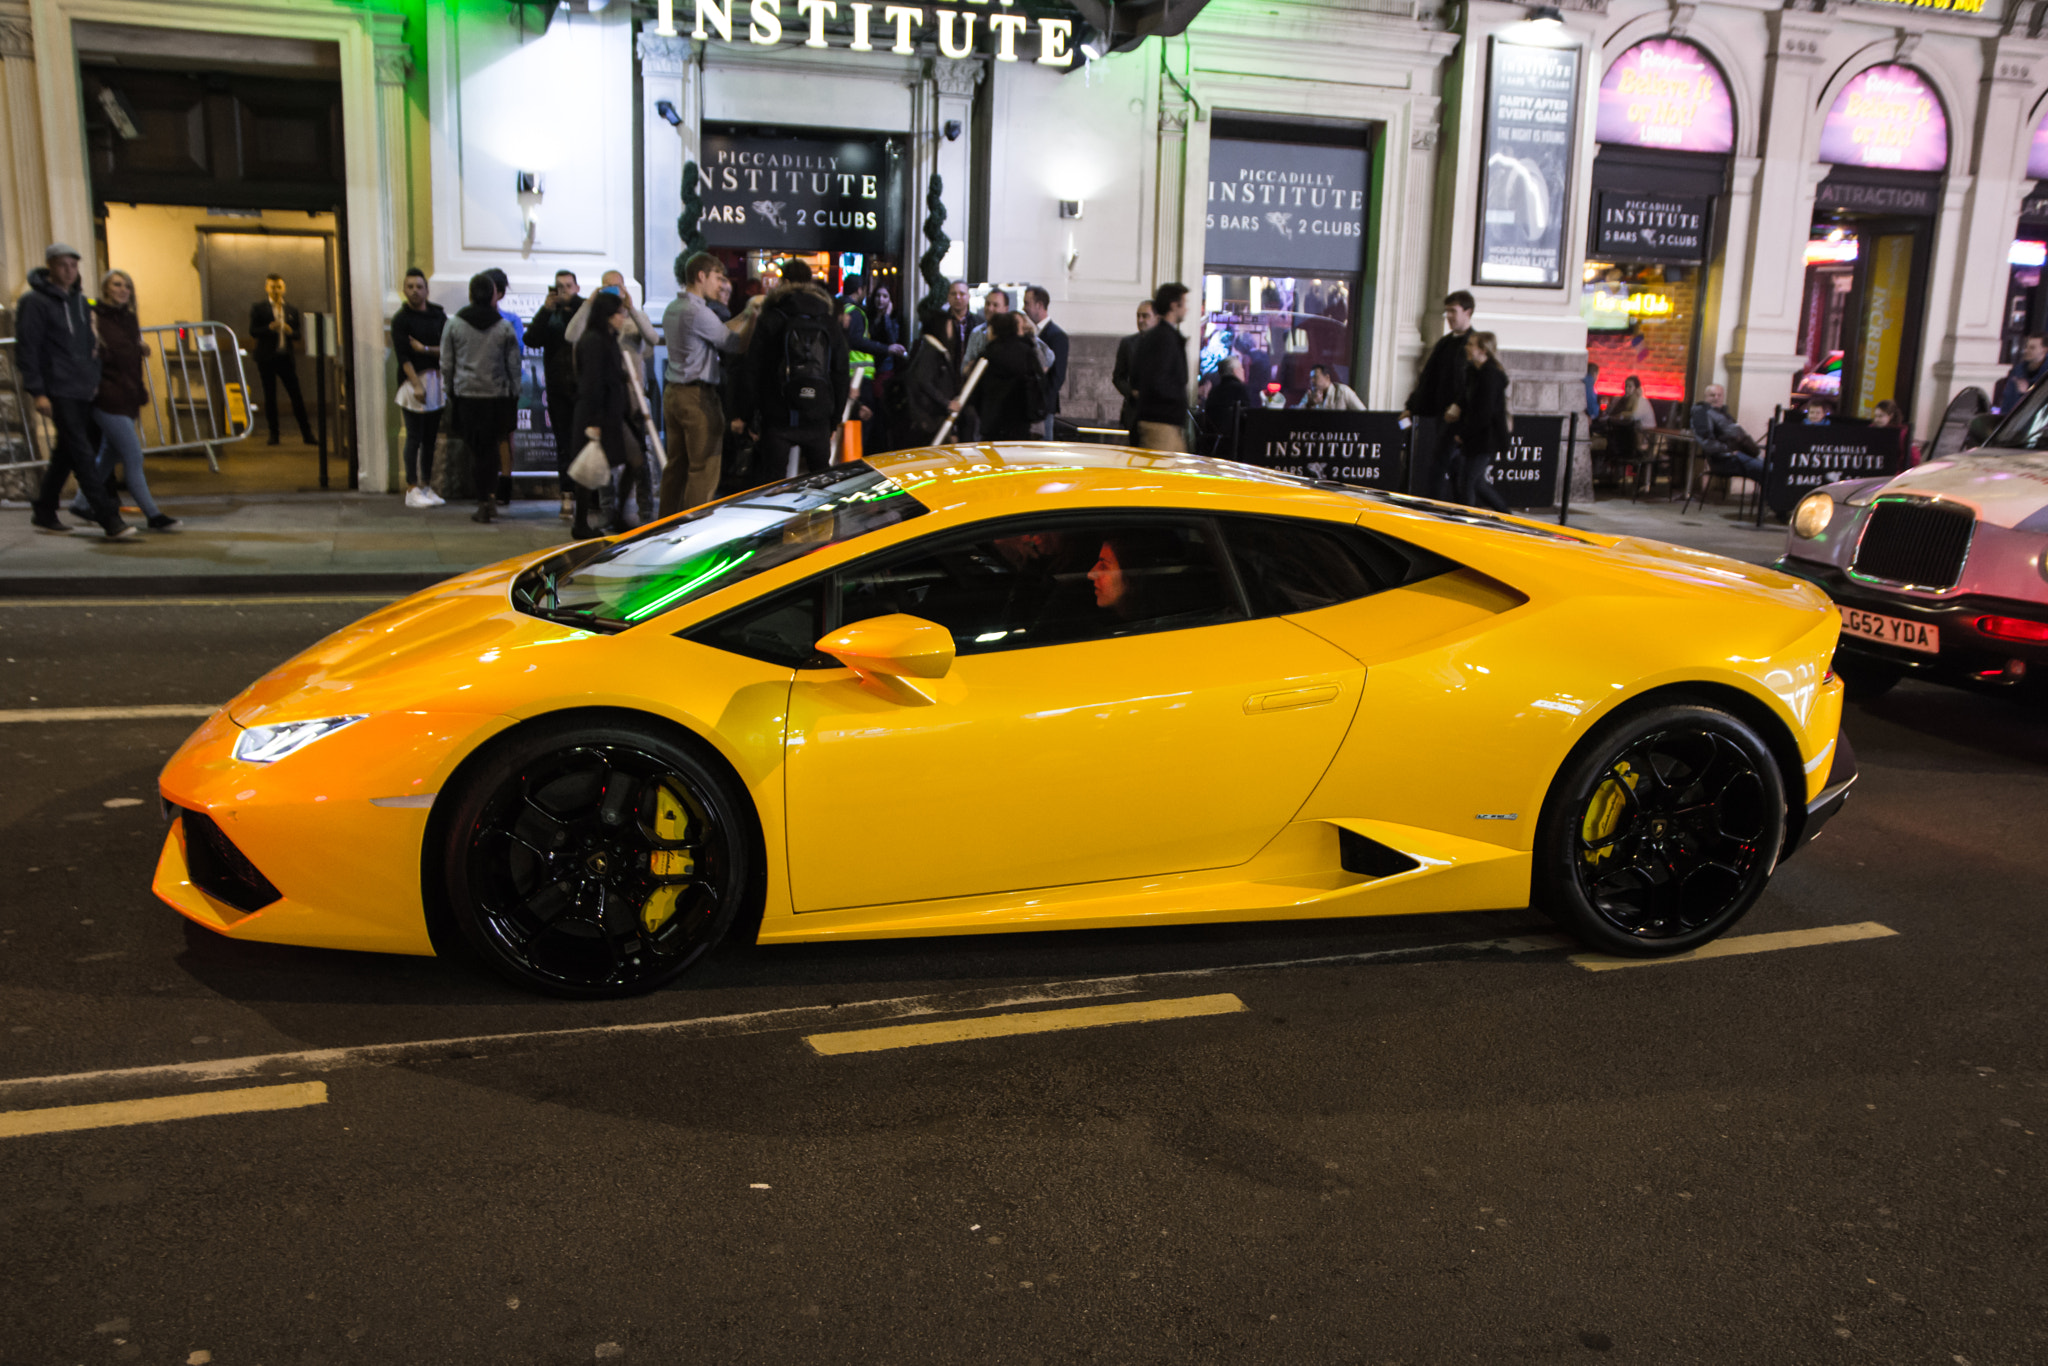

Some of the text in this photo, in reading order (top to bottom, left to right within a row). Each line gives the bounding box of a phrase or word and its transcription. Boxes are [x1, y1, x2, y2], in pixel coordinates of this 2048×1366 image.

[653, 0, 1074, 66] INSTITUTE
[1617, 68, 1691, 99] Believe
[1499, 94, 1568, 111] PARTY AFTER
[1498, 106, 1567, 124] EVERY GAME
[1627, 104, 1651, 122] or
[718, 150, 838, 170] PICCADILLY
[699, 166, 877, 199] NSTITUTE
[1239, 168, 1334, 187] PICCADILLY
[1208, 181, 1363, 211] INSTITUTE
[1821, 184, 1927, 207] ATTRACTION
[1625, 200, 1682, 213] PICCADILLY
[796, 209, 807, 226] 2
[813, 210, 877, 230] CLUBS
[1206, 213, 1361, 237] 5 BARS 2 CLUBS
[1606, 208, 1699, 229] INSTITUTE
[1605, 230, 1697, 247] 5 BARS 2 CLUBS
[1289, 431, 1360, 442] PICCADILLY
[1265, 441, 1381, 459] INSTITUTE
[1790, 452, 1885, 470] INSTITUTE
[1332, 466, 1339, 478] 2
[1342, 466, 1380, 479] CLUBS
[1497, 469, 1540, 480] 2 CLUBS
[1796, 474, 1822, 486] BARS
[1890, 619, 1929, 646] YDA
